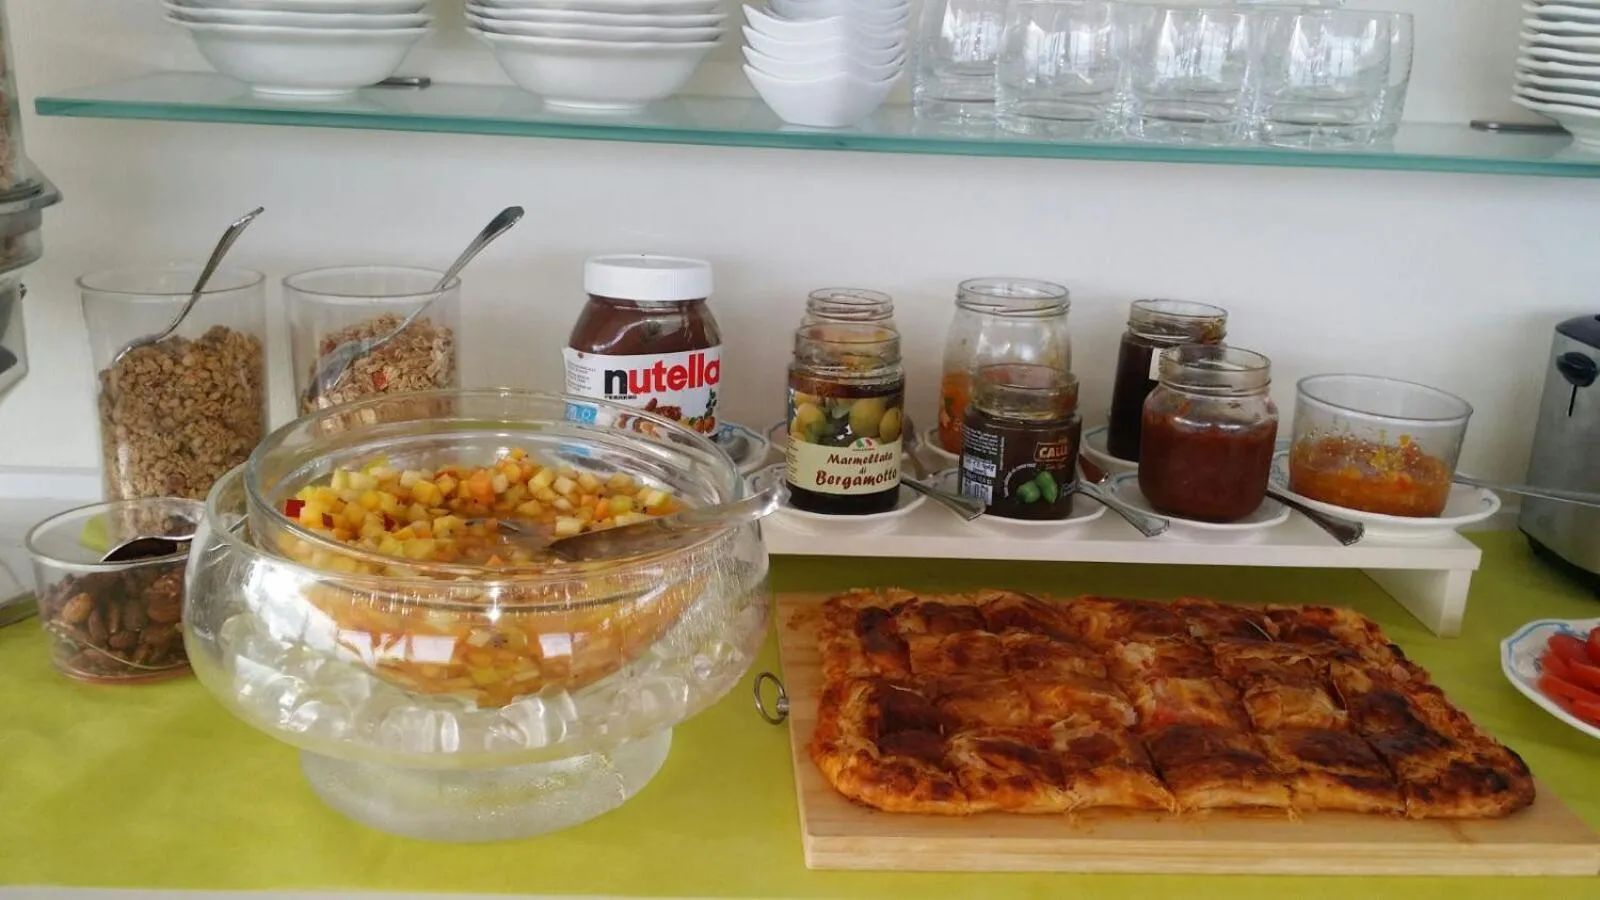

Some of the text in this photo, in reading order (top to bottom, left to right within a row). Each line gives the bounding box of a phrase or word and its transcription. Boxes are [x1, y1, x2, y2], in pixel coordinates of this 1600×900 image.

[604, 353, 720, 395] nutella
[827, 452, 893, 465] Marmellata
[815, 468, 897, 490] Bergamotto
[859, 466, 867, 475] di
